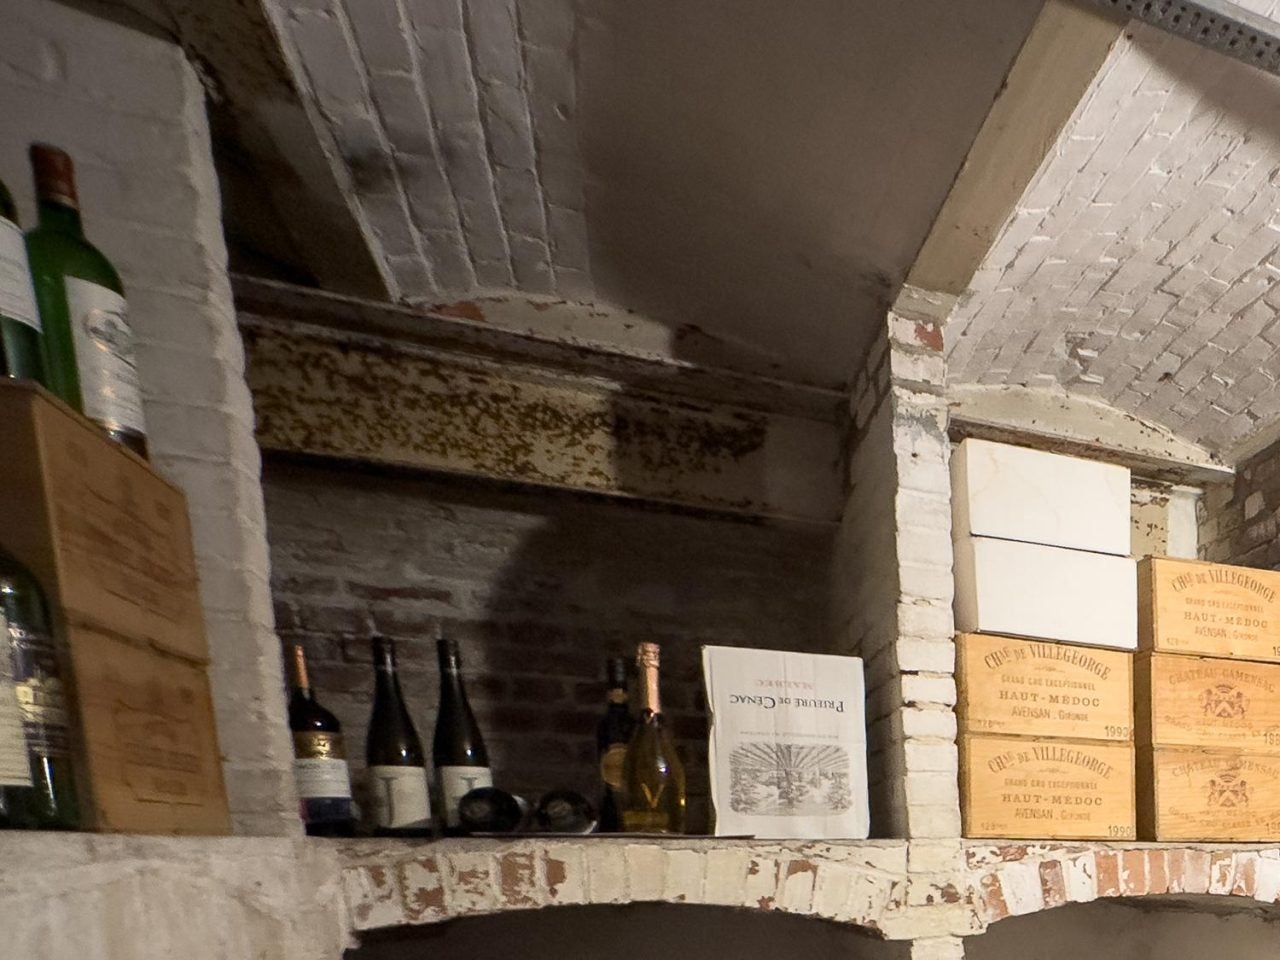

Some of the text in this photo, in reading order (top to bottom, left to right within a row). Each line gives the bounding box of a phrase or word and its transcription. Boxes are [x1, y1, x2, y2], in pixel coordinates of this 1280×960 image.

[1195, 573, 1207, 585] DE
[1208, 569, 1276, 603] VILLEGEORGE
[1014, 648, 1026, 660] DE
[1028, 644, 1112, 681] VILLEGEORGE
[756, 678, 817, 690] MALBEC
[778, 696, 792, 705] DE
[1011, 705, 1050, 720] AVENSAN
[1018, 751, 1030, 764] DE
[1032, 746, 1114, 779] VILLEGEORGE
[1014, 807, 1053, 820] AVENSAN
[1108, 824, 1131, 838] 1990
